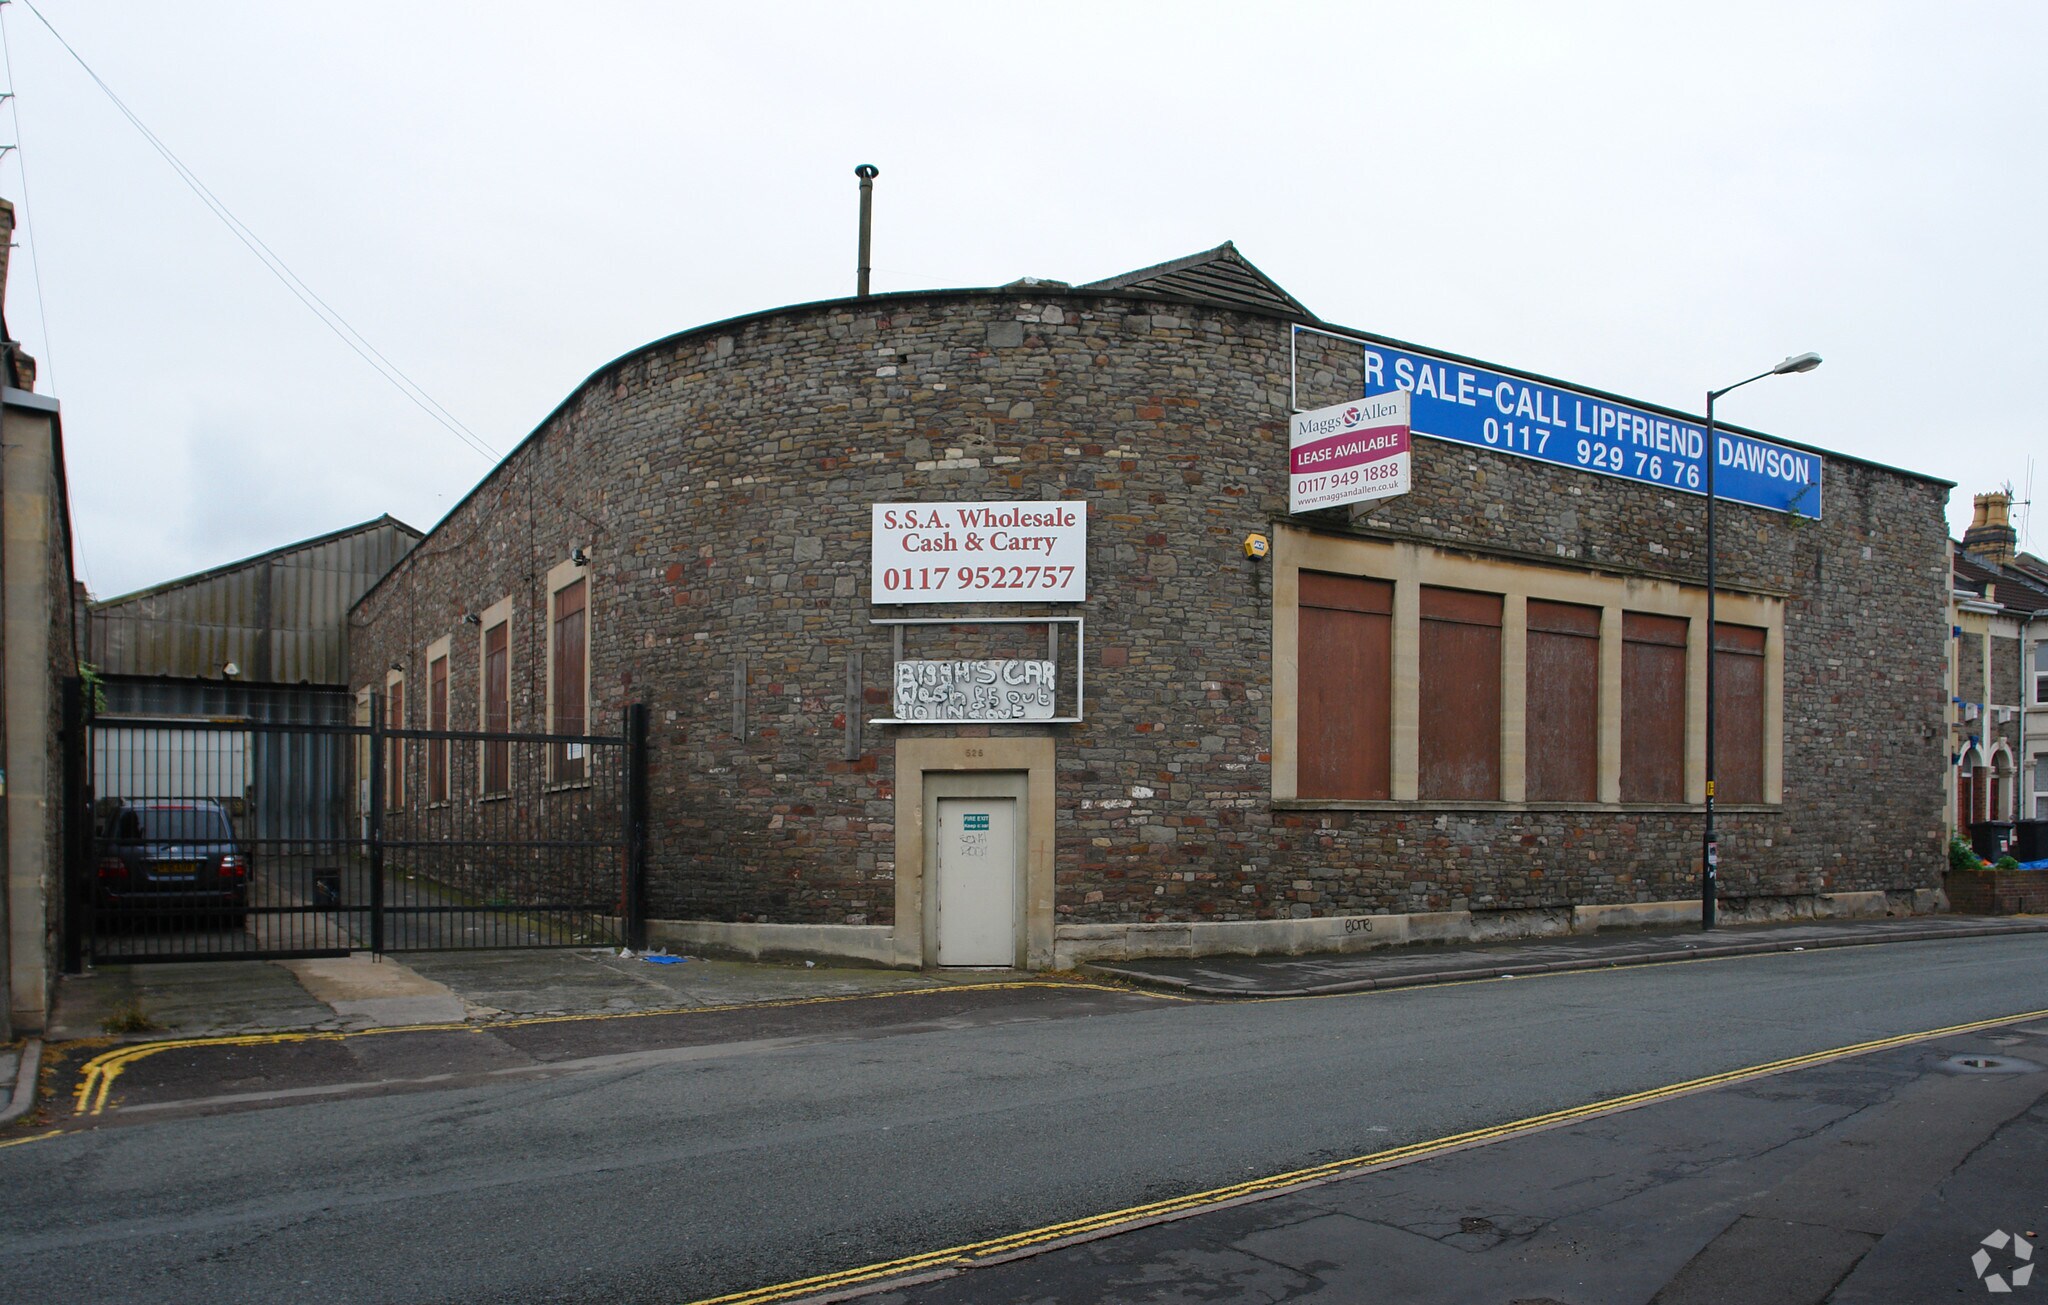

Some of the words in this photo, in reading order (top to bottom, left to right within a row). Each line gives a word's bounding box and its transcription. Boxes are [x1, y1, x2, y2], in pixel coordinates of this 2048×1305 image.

[1299, 416, 1341, 435] Maggs
[1361, 403, 1397, 421] Allen
[1395, 358, 1567, 428] SALE-CALL
[1576, 401, 1704, 459] LIPFRIEND
[1718, 437, 1809, 484] DAWSON
[1298, 447, 1332, 466] LEASE
[1334, 434, 1398, 458] AVAILABLE
[1483, 418, 1550, 454] 0117
[1577, 439, 1624, 471] 929
[1634, 452, 1662, 480] 76
[1672, 461, 1700, 488] 76
[1297, 481, 1399, 506] www.maggsandallen.co.uk
[1298, 477, 1327, 494] 0117
[1331, 470, 1359, 488] 949
[1363, 462, 1399, 481] 1888
[884, 509, 951, 530] S.S.A.
[957, 507, 1076, 529] Wholesale
[902, 532, 958, 552] Cash
[964, 532, 985, 551] &
[990, 532, 1058, 556] Carry
[884, 567, 951, 590] 0117
[957, 566, 1076, 590] 9522757
[1002, 660, 1056, 691] CAR
